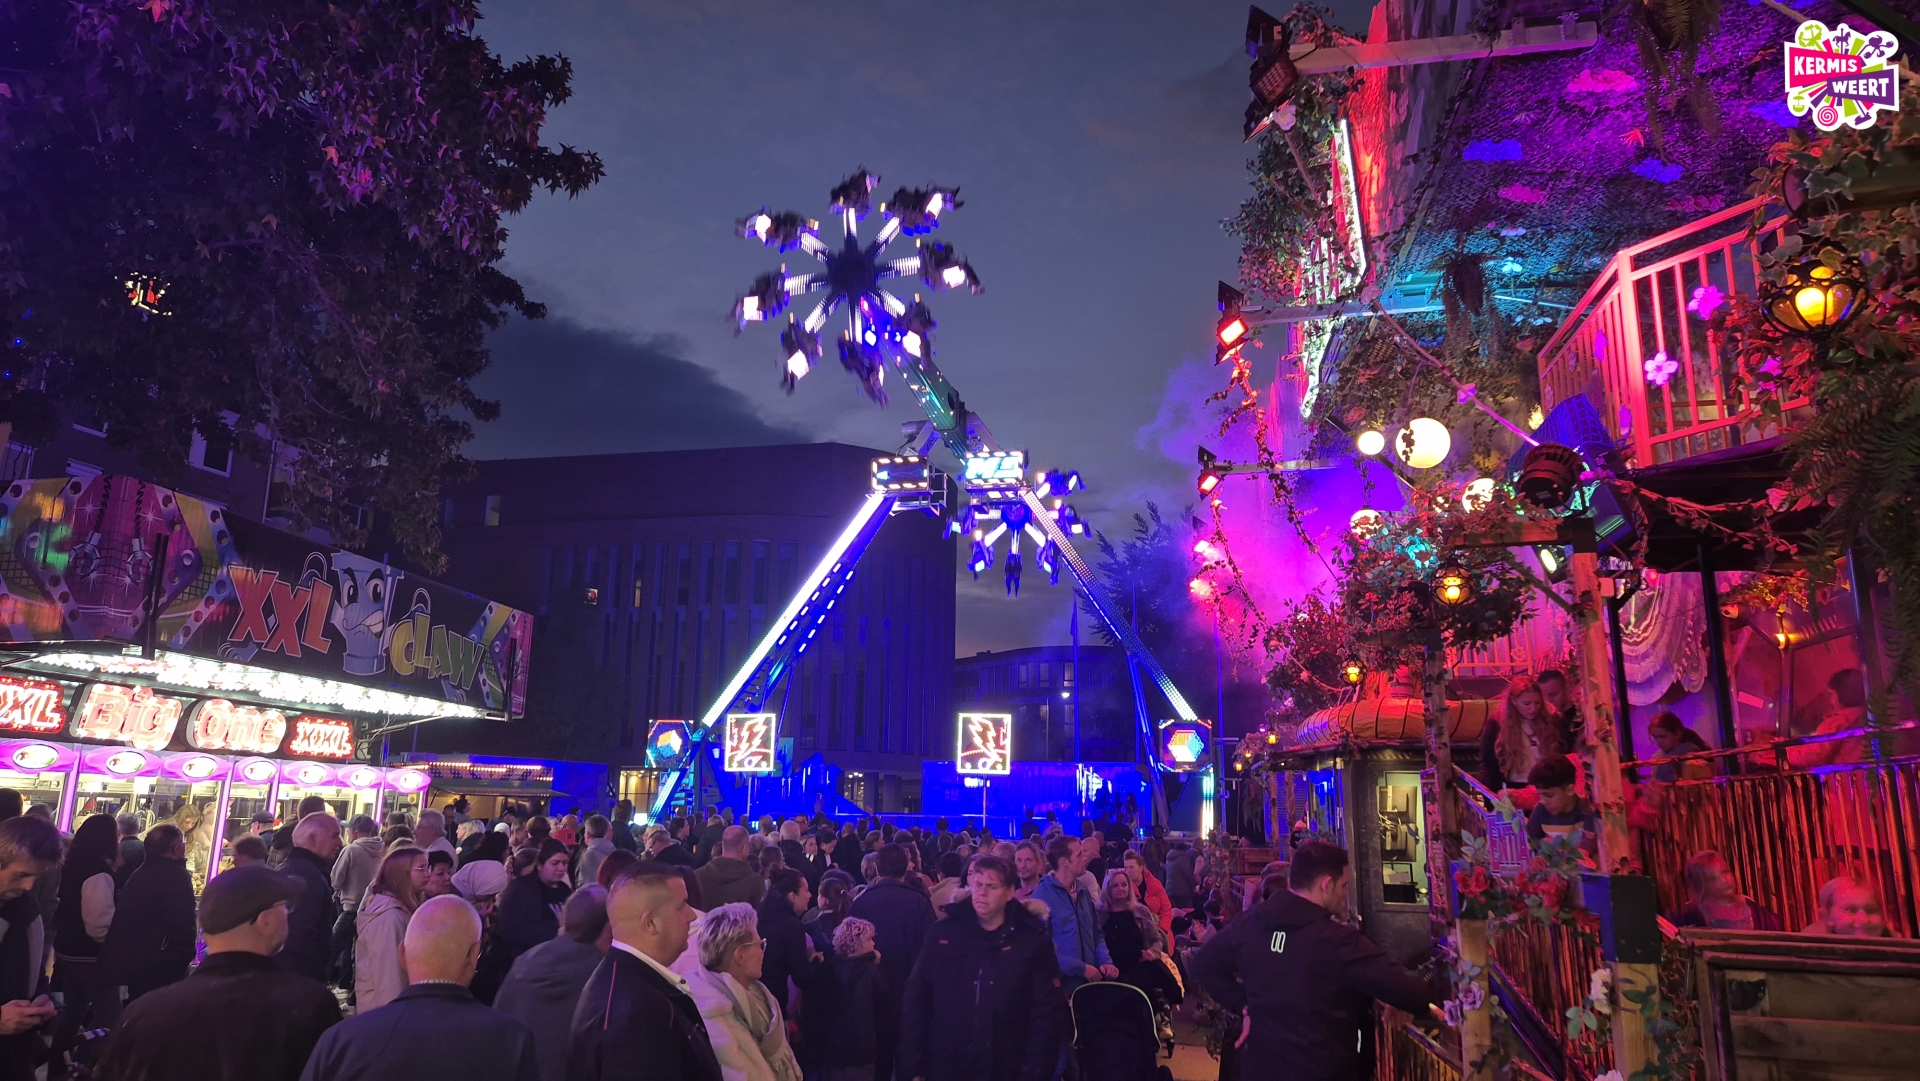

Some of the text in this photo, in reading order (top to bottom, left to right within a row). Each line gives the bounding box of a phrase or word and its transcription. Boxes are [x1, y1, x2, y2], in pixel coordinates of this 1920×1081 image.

[227, 565, 484, 690] XXL CLAW
[0, 684, 61, 727] XL
[82, 687, 284, 747] Big One
[290, 721, 352, 755] XXL
